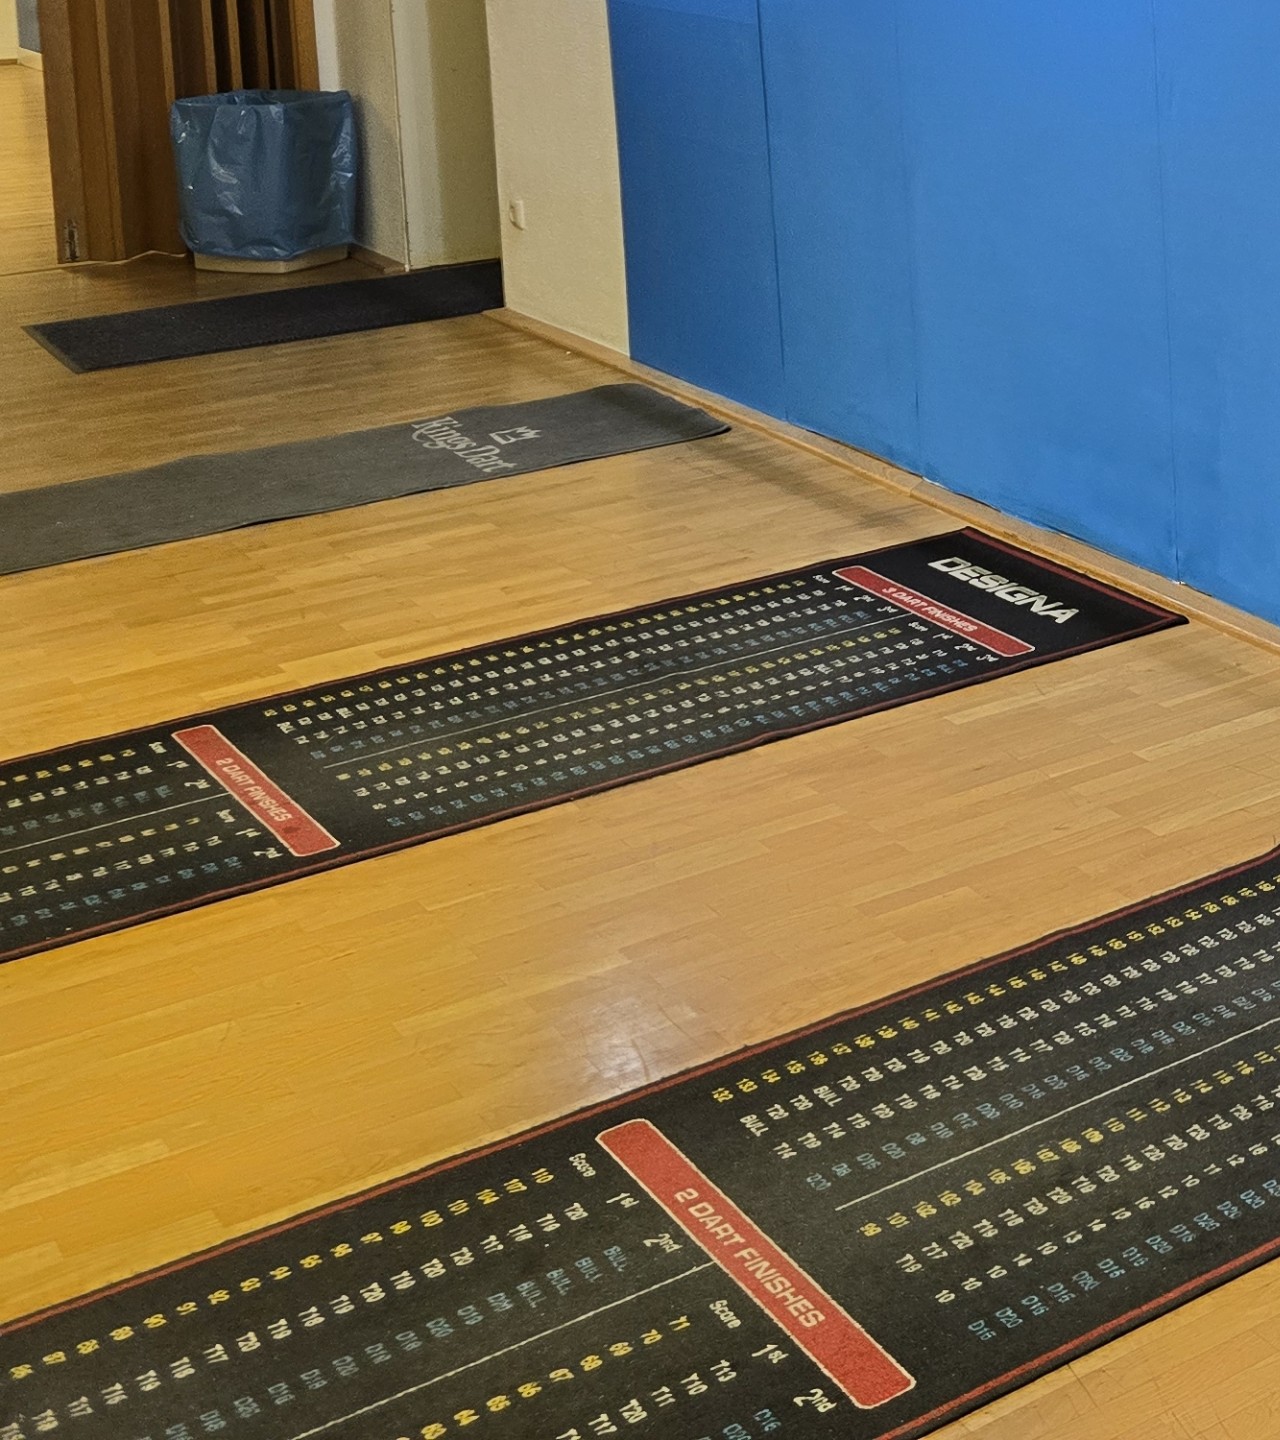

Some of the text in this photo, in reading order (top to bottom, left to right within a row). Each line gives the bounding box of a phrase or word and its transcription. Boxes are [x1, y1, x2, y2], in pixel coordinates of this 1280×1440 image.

[411, 416, 517, 473] Kings Dart
[882, 586, 979, 633] 3 DART FINISHES
[928, 556, 1079, 624] DESIGNA
[216, 757, 293, 822] 2 DART FINISHES
[674, 1188, 826, 1328] 2 DART FINISHES
[709, 1299, 838, 1413] Score 1st 2nd
